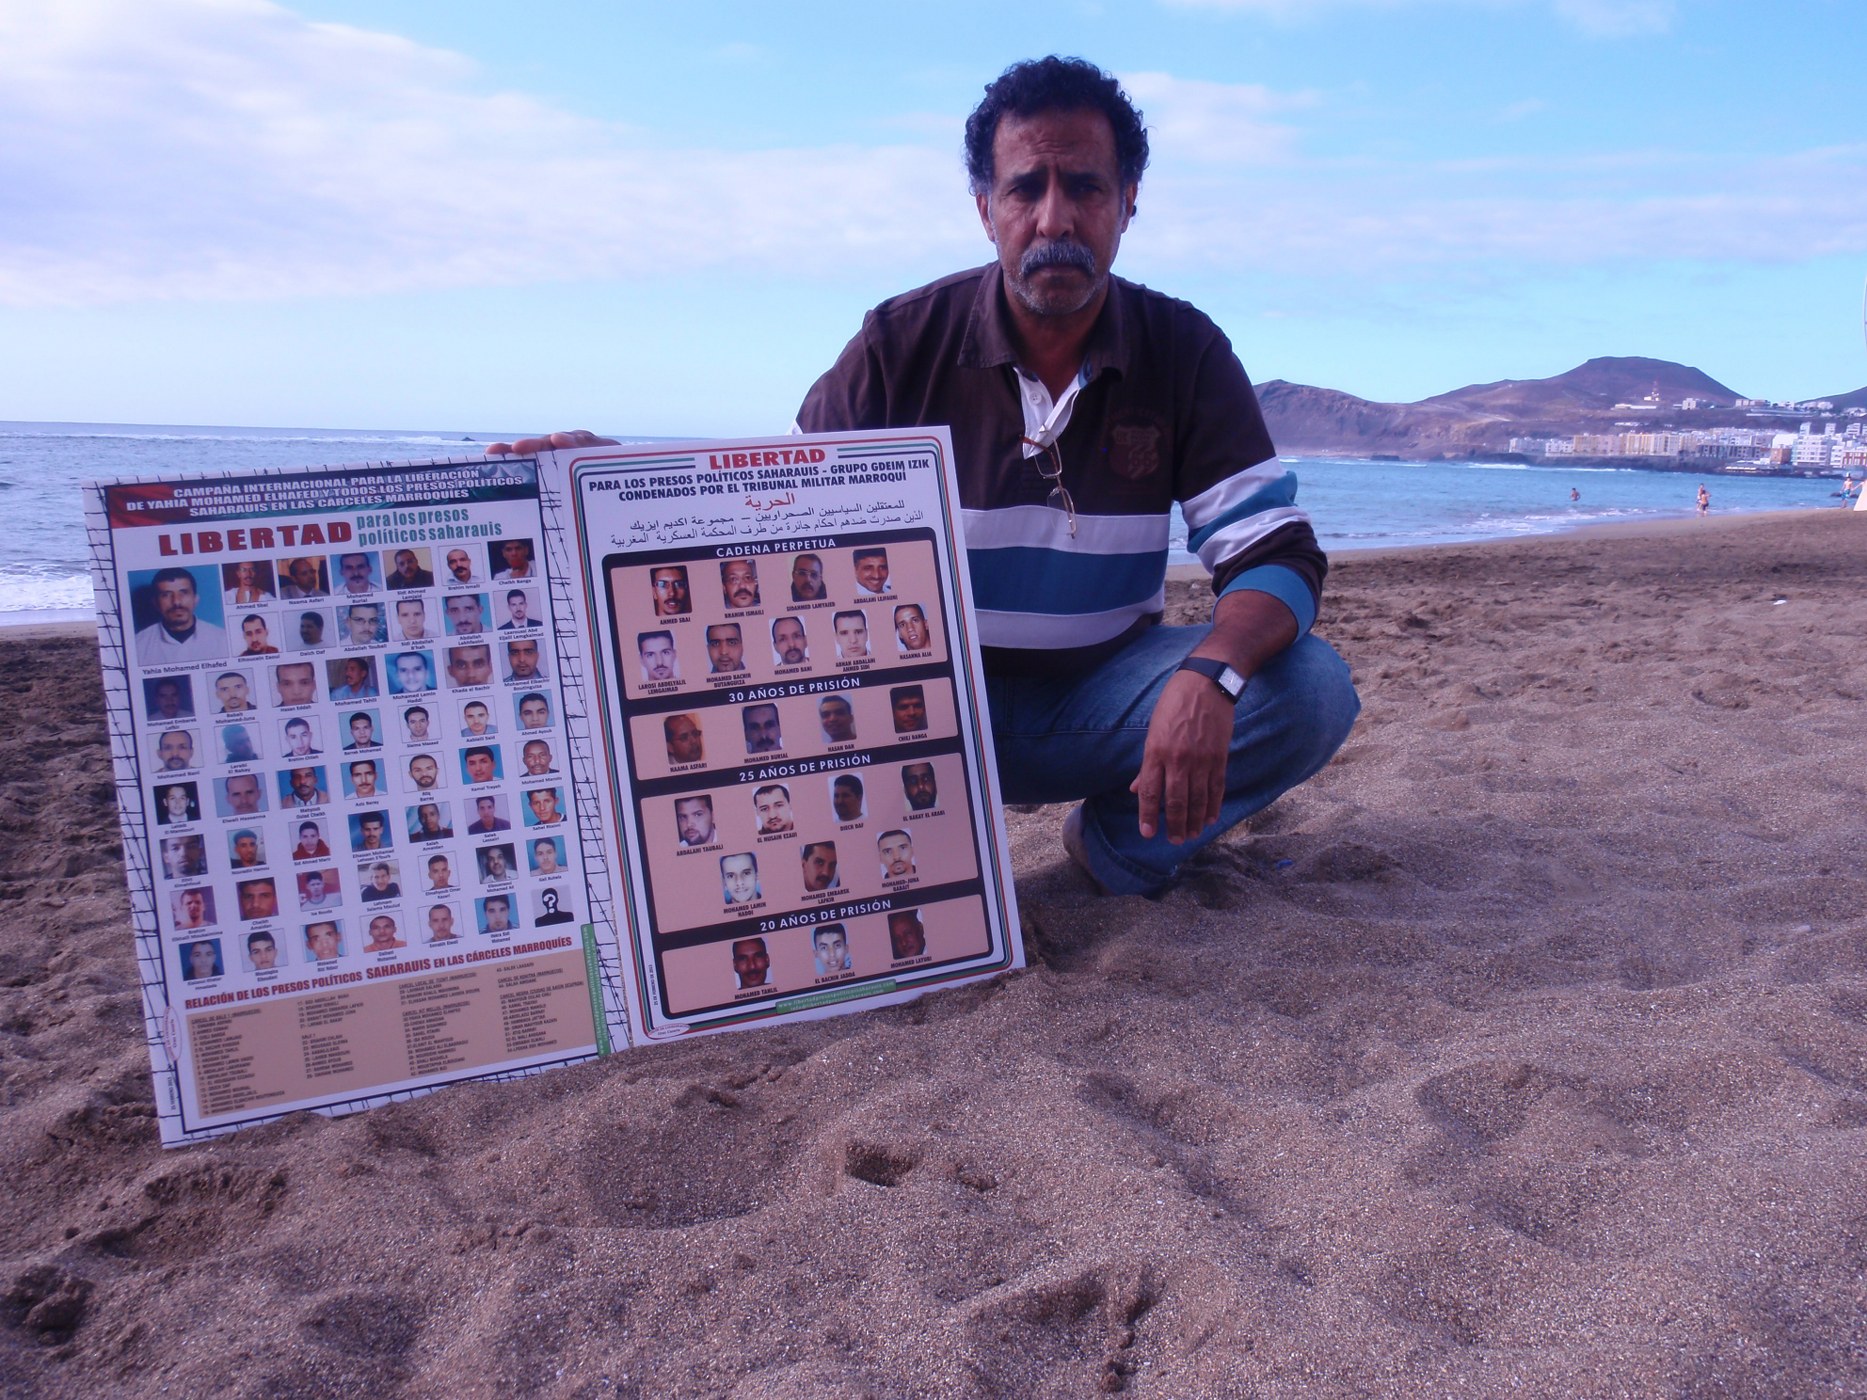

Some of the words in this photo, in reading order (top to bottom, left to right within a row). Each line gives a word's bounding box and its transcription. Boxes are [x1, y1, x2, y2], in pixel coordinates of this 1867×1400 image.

[709, 448, 826, 470] LIBERTAD
[589, 480, 622, 492] PARA
[624, 478, 646, 489] LOS
[650, 475, 693, 488] PRESOS
[697, 469, 754, 484] POLÍTICOS
[758, 466, 819, 480] SAHARAUIS
[830, 462, 868, 474] GRUPO
[871, 460, 905, 472] GDEIM
[908, 459, 930, 470] IZIK
[174, 485, 239, 498] CAMPAÑA
[243, 479, 348, 493] INTERNACIONAL
[351, 475, 384, 486] PARA
[388, 474, 403, 484] LA
[618, 487, 697, 502] CONDENADOS
[700, 485, 724, 496] POR
[727, 484, 740, 494] EL
[742, 478, 798, 492] TRIBUNAL
[801, 475, 845, 488] MILITAR
[848, 471, 907, 485] MARROQUÍ
[126, 502, 145, 512] DE
[147, 499, 188, 510] YAHIA
[192, 494, 260, 507] MOHAMED
[264, 490, 320, 502] ELHAFED
[322, 489, 330, 498] Y
[334, 485, 377, 498] TODOS
[380, 484, 403, 494] LOS
[406, 480, 455, 492] PRESOS
[745, 492, 795, 512] الحرية
[190, 503, 268, 517] SAHARAUIS
[271, 501, 288, 511] EN
[291, 498, 315, 510] LAS
[819, 504, 862, 518] السياسيين
[866, 500, 905, 514] للمعتقلين
[356, 512, 393, 530] para
[393, 511, 416, 526] los
[418, 508, 469, 528] presos
[692, 515, 734, 527] مجموعة
[756, 507, 814, 522] الصحراويين
[870, 514, 901, 526] صدرت
[904, 510, 924, 523] الذين
[630, 520, 658, 532] ايزيك
[700, 524, 737, 538] المحكمة
[740, 523, 766, 536] طرف
[770, 525, 784, 535] من
[158, 521, 352, 557] LIBERTAD
[358, 526, 426, 548] políticos
[429, 521, 502, 540] saharauis
[611, 533, 649, 548] المغربية
[656, 529, 698, 544] العسكرية
[716, 544, 771, 558] CADENA
[774, 539, 836, 552] PERPETUA
[660, 617, 678, 625] AHMED
[163, 664, 200, 674] Mohamed
[201, 662, 228, 670] Elhafed
[774, 667, 800, 675] MOHAMED
[706, 675, 732, 683] MOHAMED
[728, 692, 744, 702] 30
[748, 686, 785, 700] AÑOS
[789, 685, 805, 695] DE
[809, 677, 861, 692] PRISIÓN
[744, 756, 769, 764] MOHAMED
[739, 771, 754, 782] 25
[758, 766, 796, 779] AÑOS
[800, 762, 816, 773] DE
[820, 754, 871, 770] PRISIÓN
[801, 893, 826, 901] MOHAMED
[724, 906, 750, 914] MOHAMED
[760, 921, 775, 932] 20
[780, 912, 816, 929] AÑOS
[820, 910, 836, 921] DE
[840, 899, 892, 917] PRISIÓN
[890, 960, 915, 968] MOHAMED
[186, 991, 235, 1010] RELACIÓN
[236, 988, 250, 1000] DE
[252, 986, 270, 999] LOS
[272, 982, 310, 996] PRESOS
[312, 972, 362, 988] POLÍTICOS
[366, 958, 431, 979] SAHARAUIS
[434, 956, 446, 968] EN
[448, 954, 464, 966] LAS
[466, 947, 512, 964] CÁRCELES
[513, 936, 572, 956] MARROQUÍES
[734, 990, 760, 999] MOHAMED
